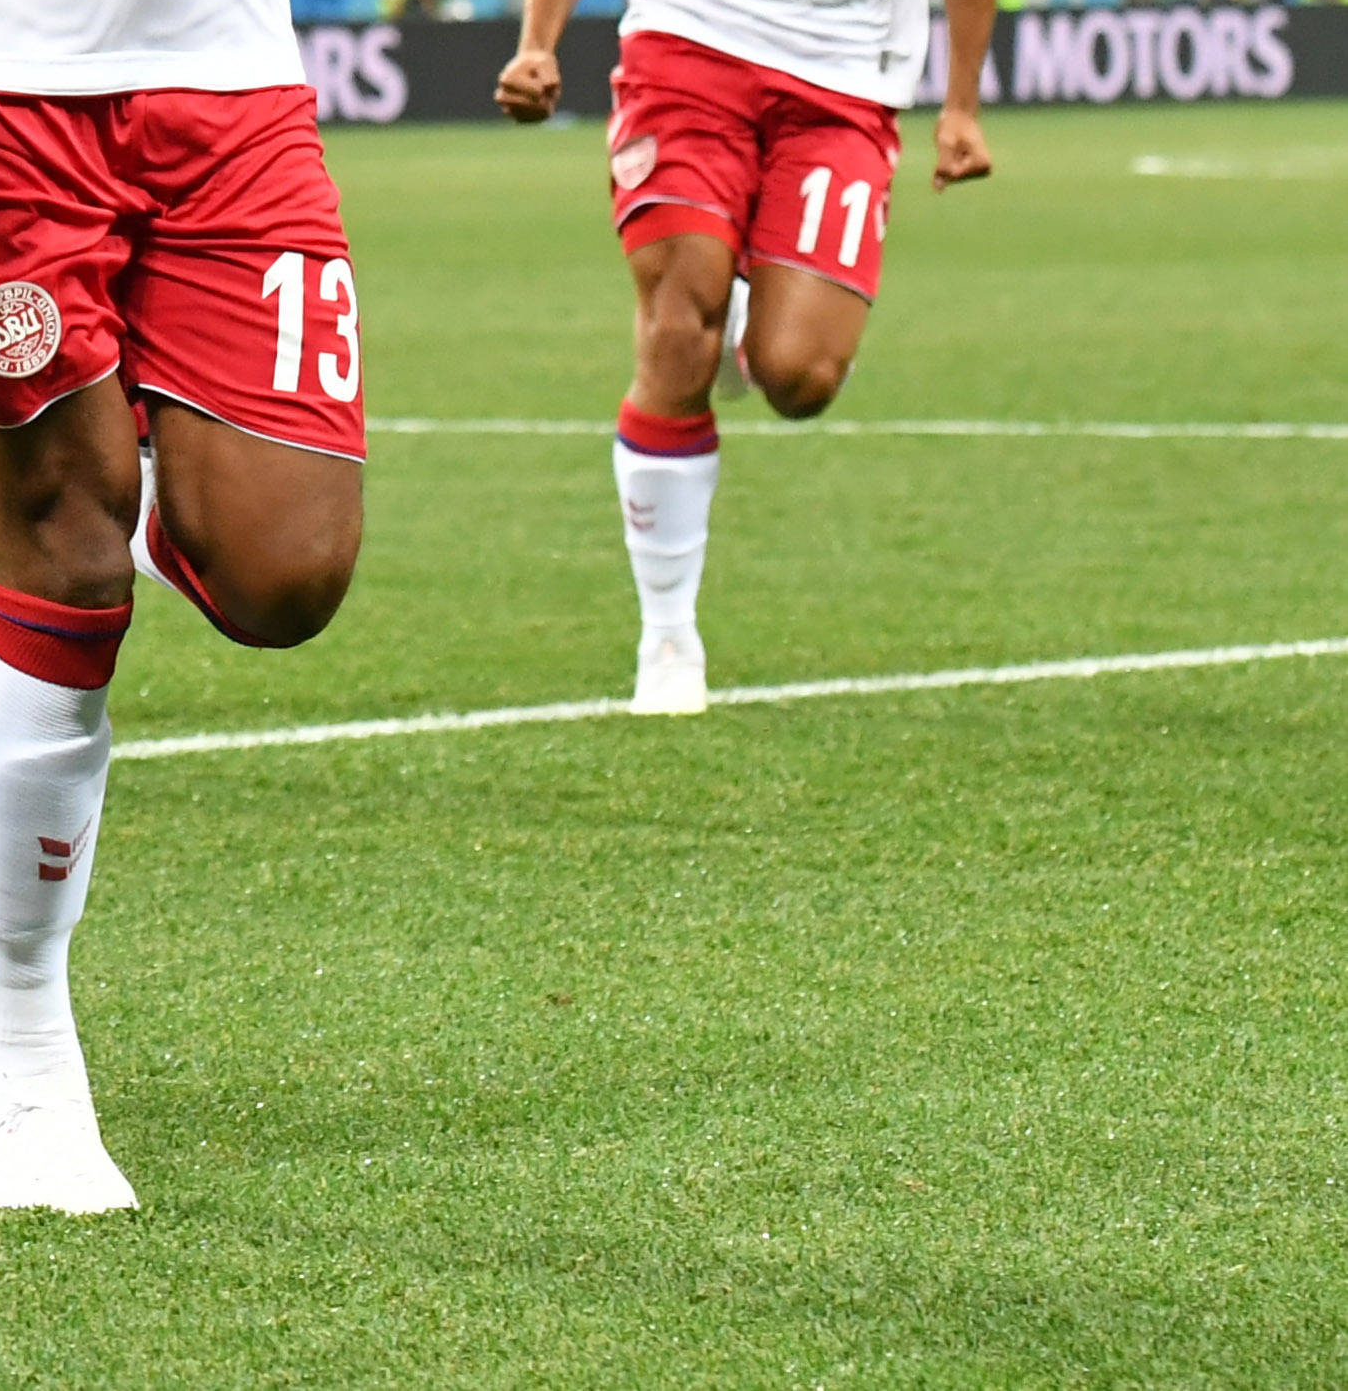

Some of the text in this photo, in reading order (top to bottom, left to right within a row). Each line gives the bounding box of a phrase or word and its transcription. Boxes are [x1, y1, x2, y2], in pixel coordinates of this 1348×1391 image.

[1013, 4, 1294, 103] MOTORS
[797, 167, 872, 267] 11
[261, 251, 360, 403] 13
